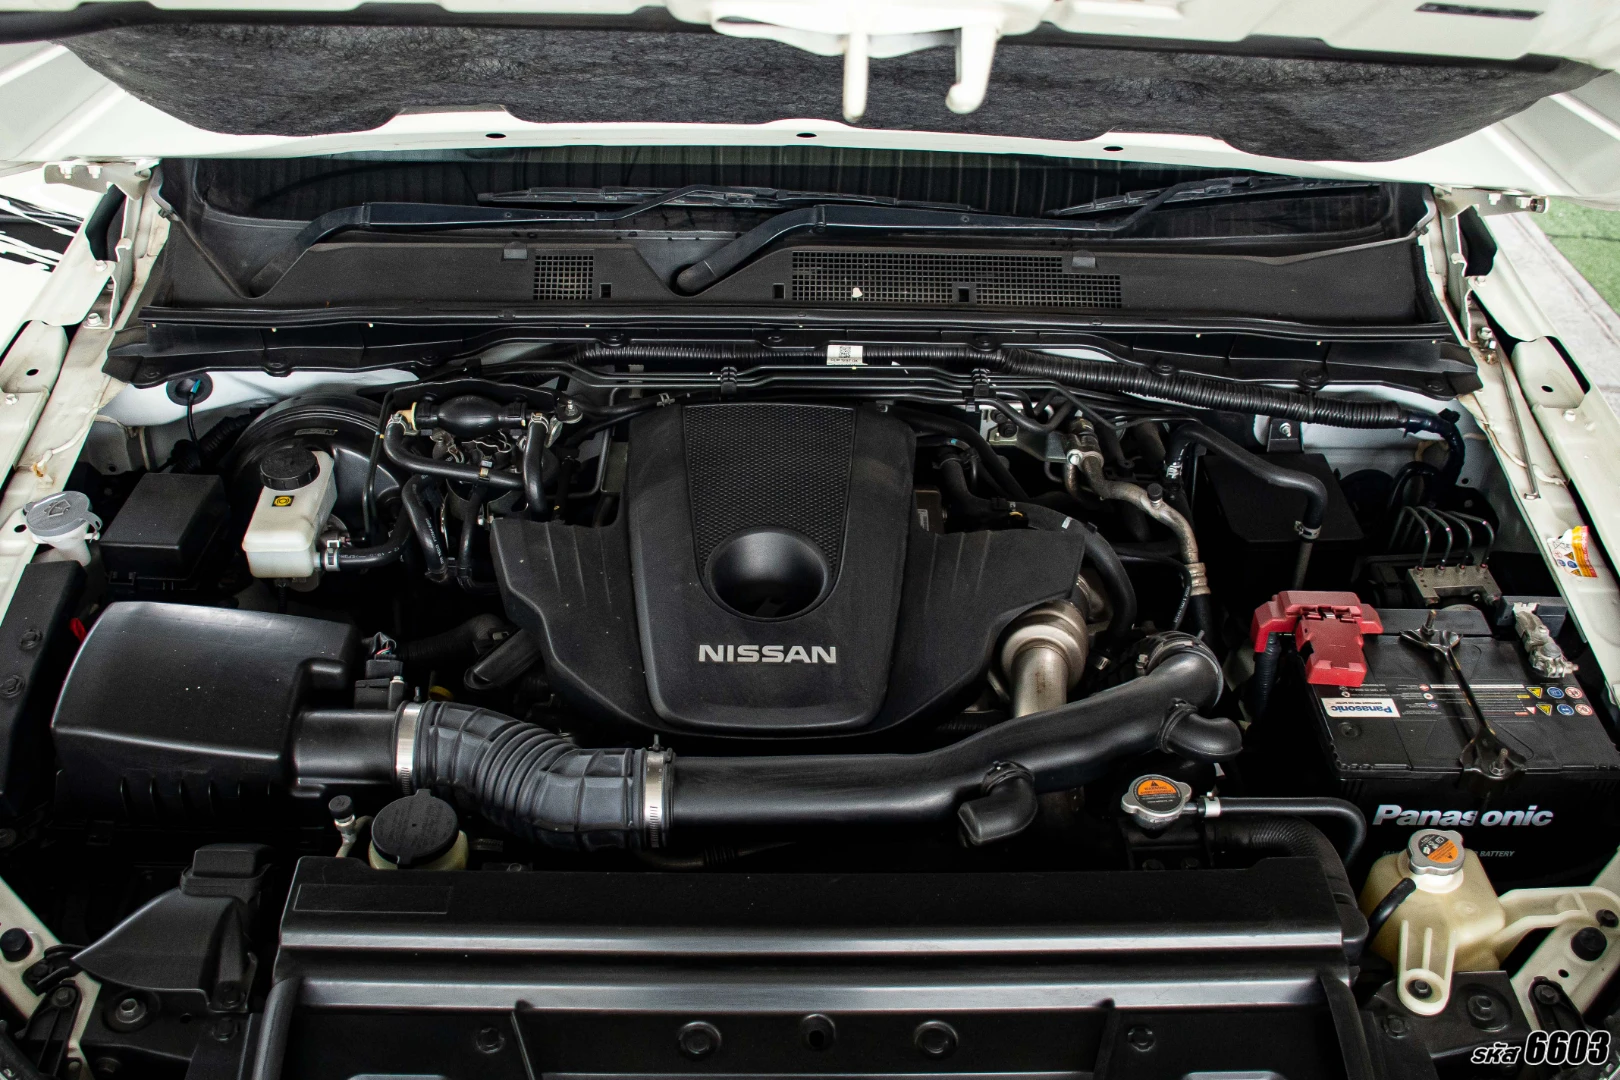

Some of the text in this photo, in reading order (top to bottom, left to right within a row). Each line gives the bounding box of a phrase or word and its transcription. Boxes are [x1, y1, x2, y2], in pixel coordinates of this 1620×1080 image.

[699, 645, 837, 663] NISSAN
[1331, 705, 1393, 714] Panasonic
[1372, 804, 1554, 827] Panasonic
